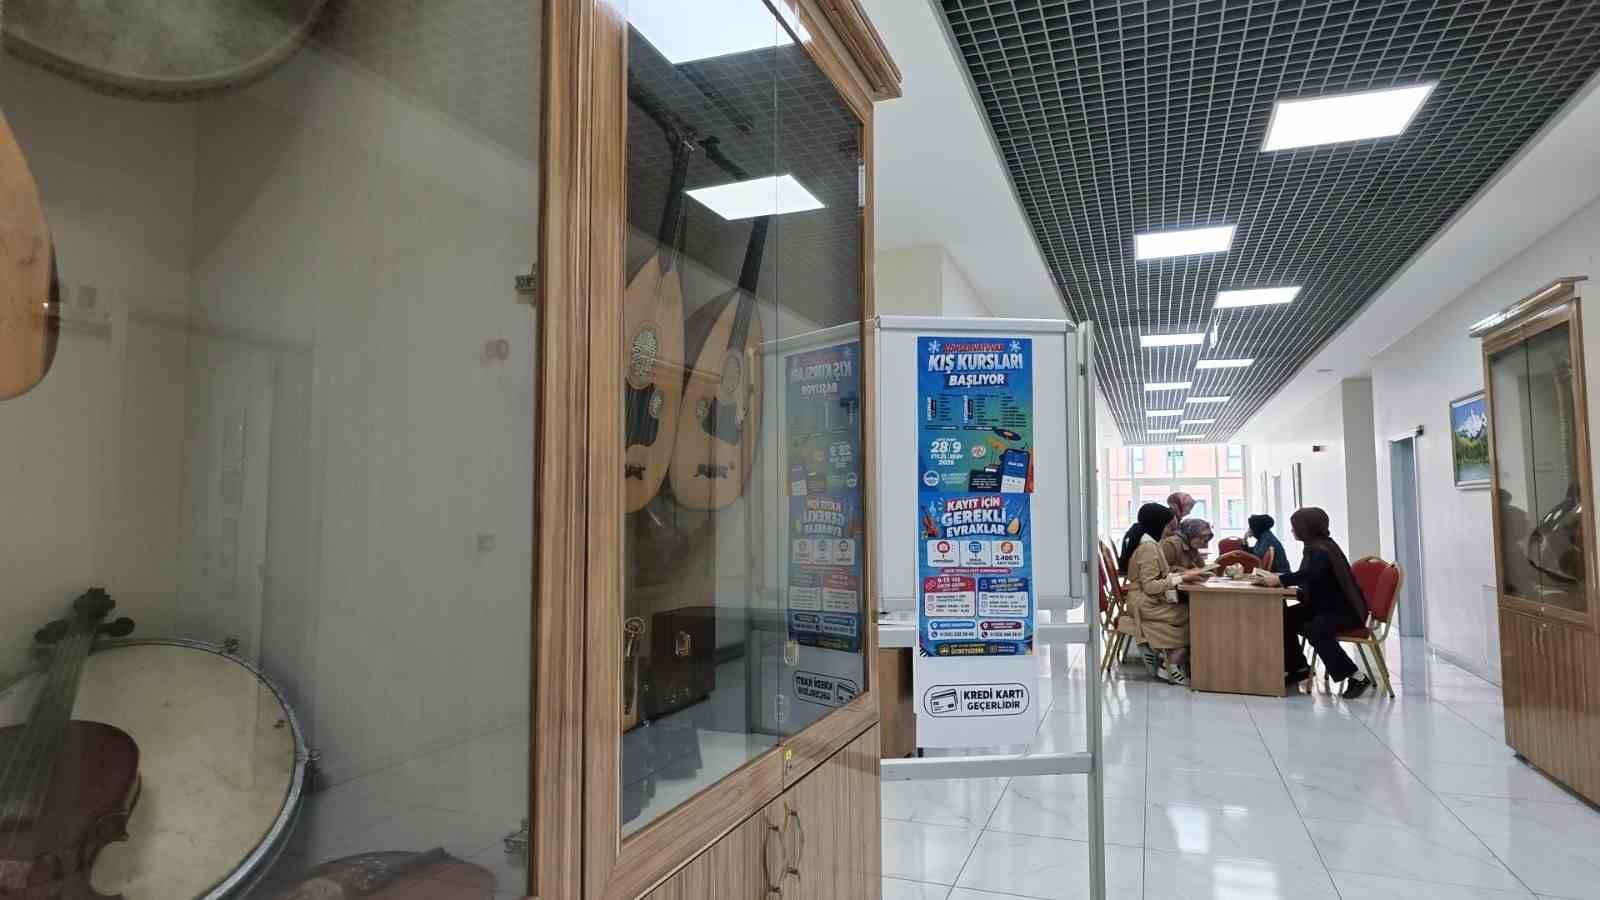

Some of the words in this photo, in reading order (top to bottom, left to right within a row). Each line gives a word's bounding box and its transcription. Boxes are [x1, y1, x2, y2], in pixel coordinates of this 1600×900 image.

[928, 353, 954, 374] KIŞ
[957, 353, 1023, 371] KURSLARI
[948, 373, 1005, 387] BAŞLIYOR
[930, 441, 948, 453] 28
[947, 498, 978, 511] KAYIT
[981, 496, 1001, 509] İÇİN
[942, 508, 1007, 525] GEREKLİ
[946, 524, 1005, 538] EVRAKLAR
[964, 688, 993, 700] KREDİ
[996, 689, 1024, 699] KARTI
[967, 699, 1021, 712] GEÇERLİDİR
